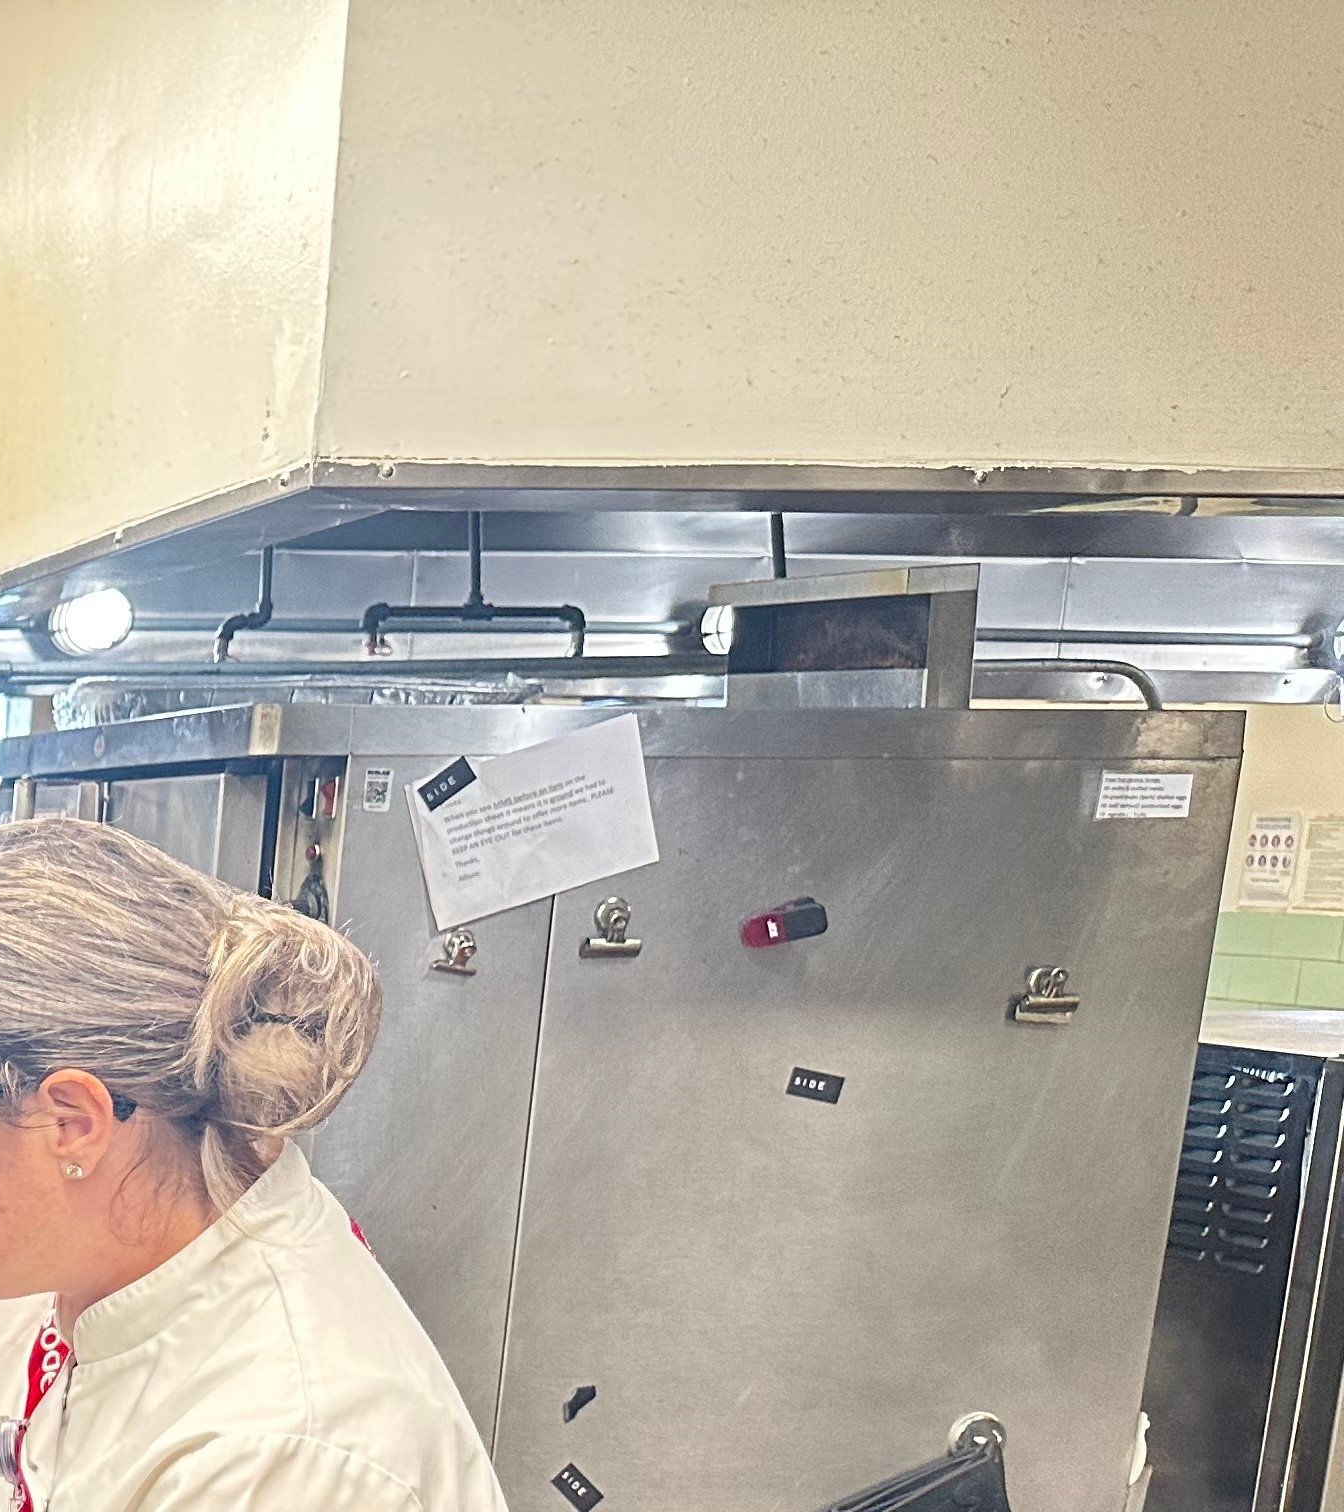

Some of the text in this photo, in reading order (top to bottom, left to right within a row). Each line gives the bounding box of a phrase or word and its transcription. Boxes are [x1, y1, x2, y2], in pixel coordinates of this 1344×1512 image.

[426, 775, 457, 802] SIDE
[794, 1076, 826, 1091] SIDE
[561, 1471, 587, 1496] SIDE
